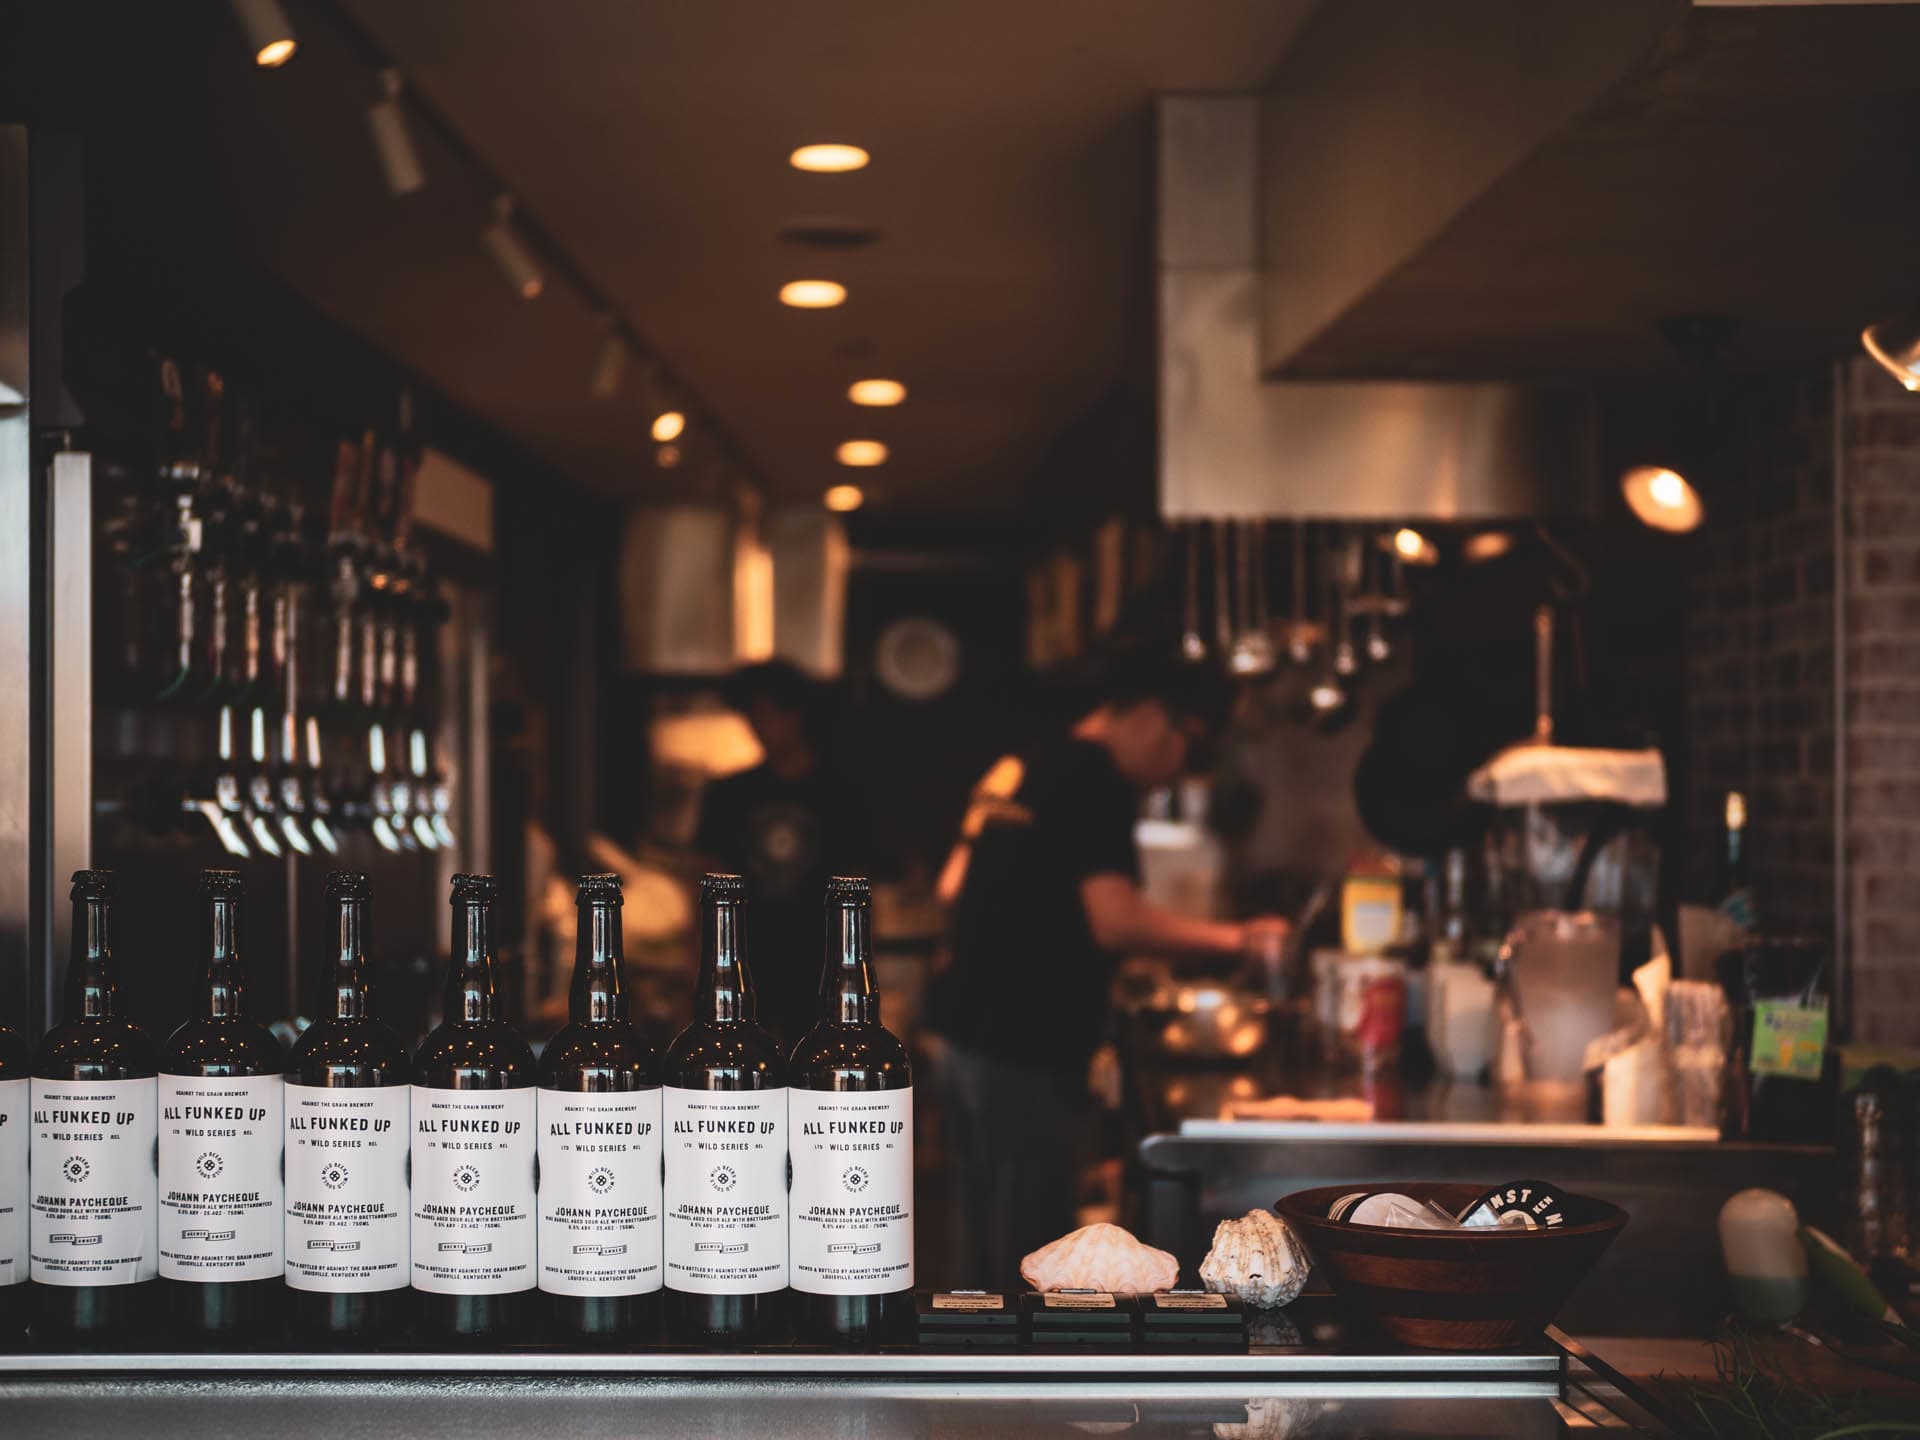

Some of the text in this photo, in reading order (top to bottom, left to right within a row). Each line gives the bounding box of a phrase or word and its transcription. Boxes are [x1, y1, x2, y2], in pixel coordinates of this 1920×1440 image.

[35, 1110, 135, 1126] ALL FUNKED UP
[164, 1106, 266, 1122] ALL FUNKED UP
[290, 1116, 391, 1133] ALL FUNKED UP
[419, 1118, 521, 1135] ALL FUNKED UP
[551, 1122, 652, 1138] ALL FUNKED UP
[674, 1119, 775, 1135] ALL FUNKED UP
[804, 1121, 904, 1137] ALL FUNKED UP
[53, 1133, 71, 1141] WILD
[185, 1129, 205, 1137] WILD
[311, 1140, 361, 1148] WILD SERIES
[442, 1142, 461, 1150] WILD
[721, 1143, 749, 1151] SERIES
[852, 1143, 880, 1151] SERIES
[168, 1191, 260, 1203] JOHANN PAYCHEQUE
[293, 1201, 385, 1213] JOHANN PAYCHEQUE
[423, 1204, 516, 1215] JOHANN PAYCHEQUE
[556, 1207, 648, 1217] JOHANN PAYCHEQUE
[678, 1204, 770, 1216] JOHANN PAYCHEQUE
[809, 1205, 901, 1216] JOHANN PAYCHEQUE
